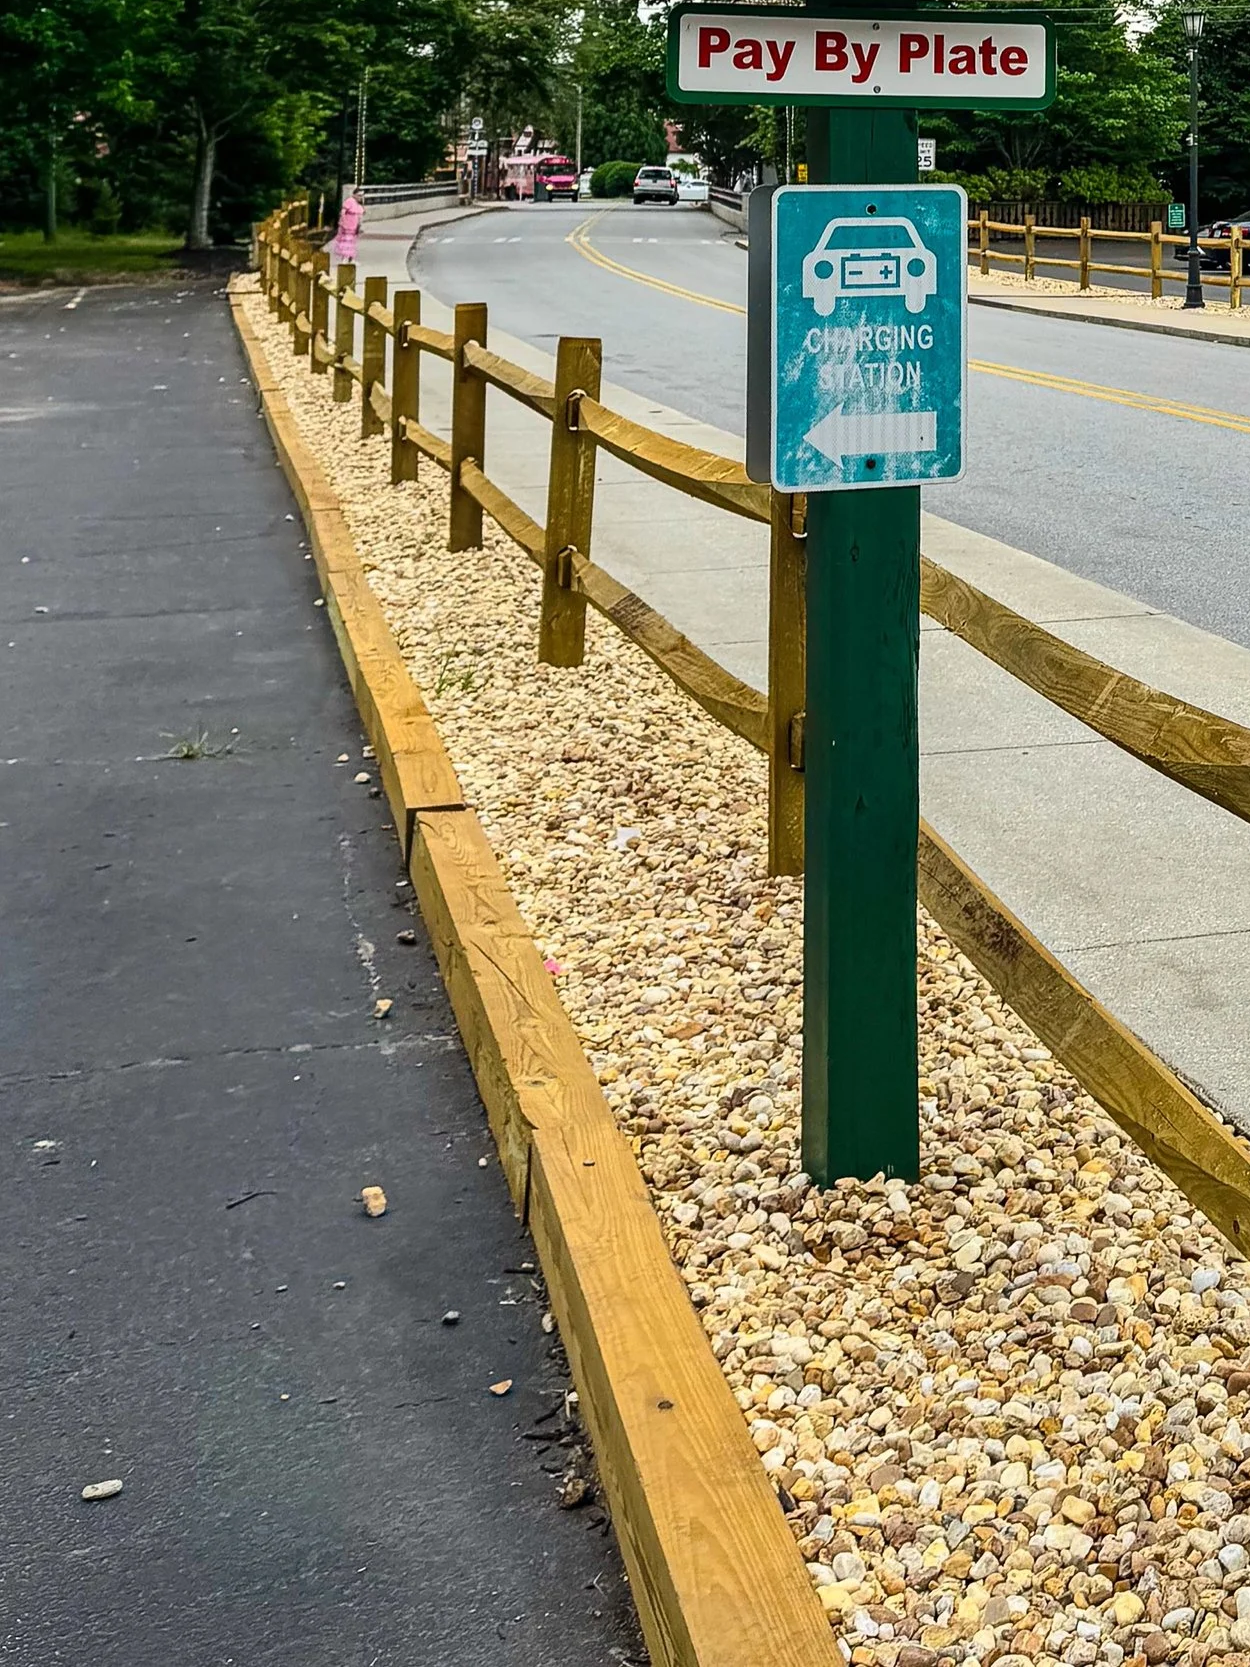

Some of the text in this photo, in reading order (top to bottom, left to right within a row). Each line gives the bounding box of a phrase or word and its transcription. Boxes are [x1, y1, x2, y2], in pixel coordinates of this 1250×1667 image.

[698, 26, 1029, 84] Pay By Plate
[807, 324, 934, 353] CHARGING
[820, 361, 921, 392] STATION
